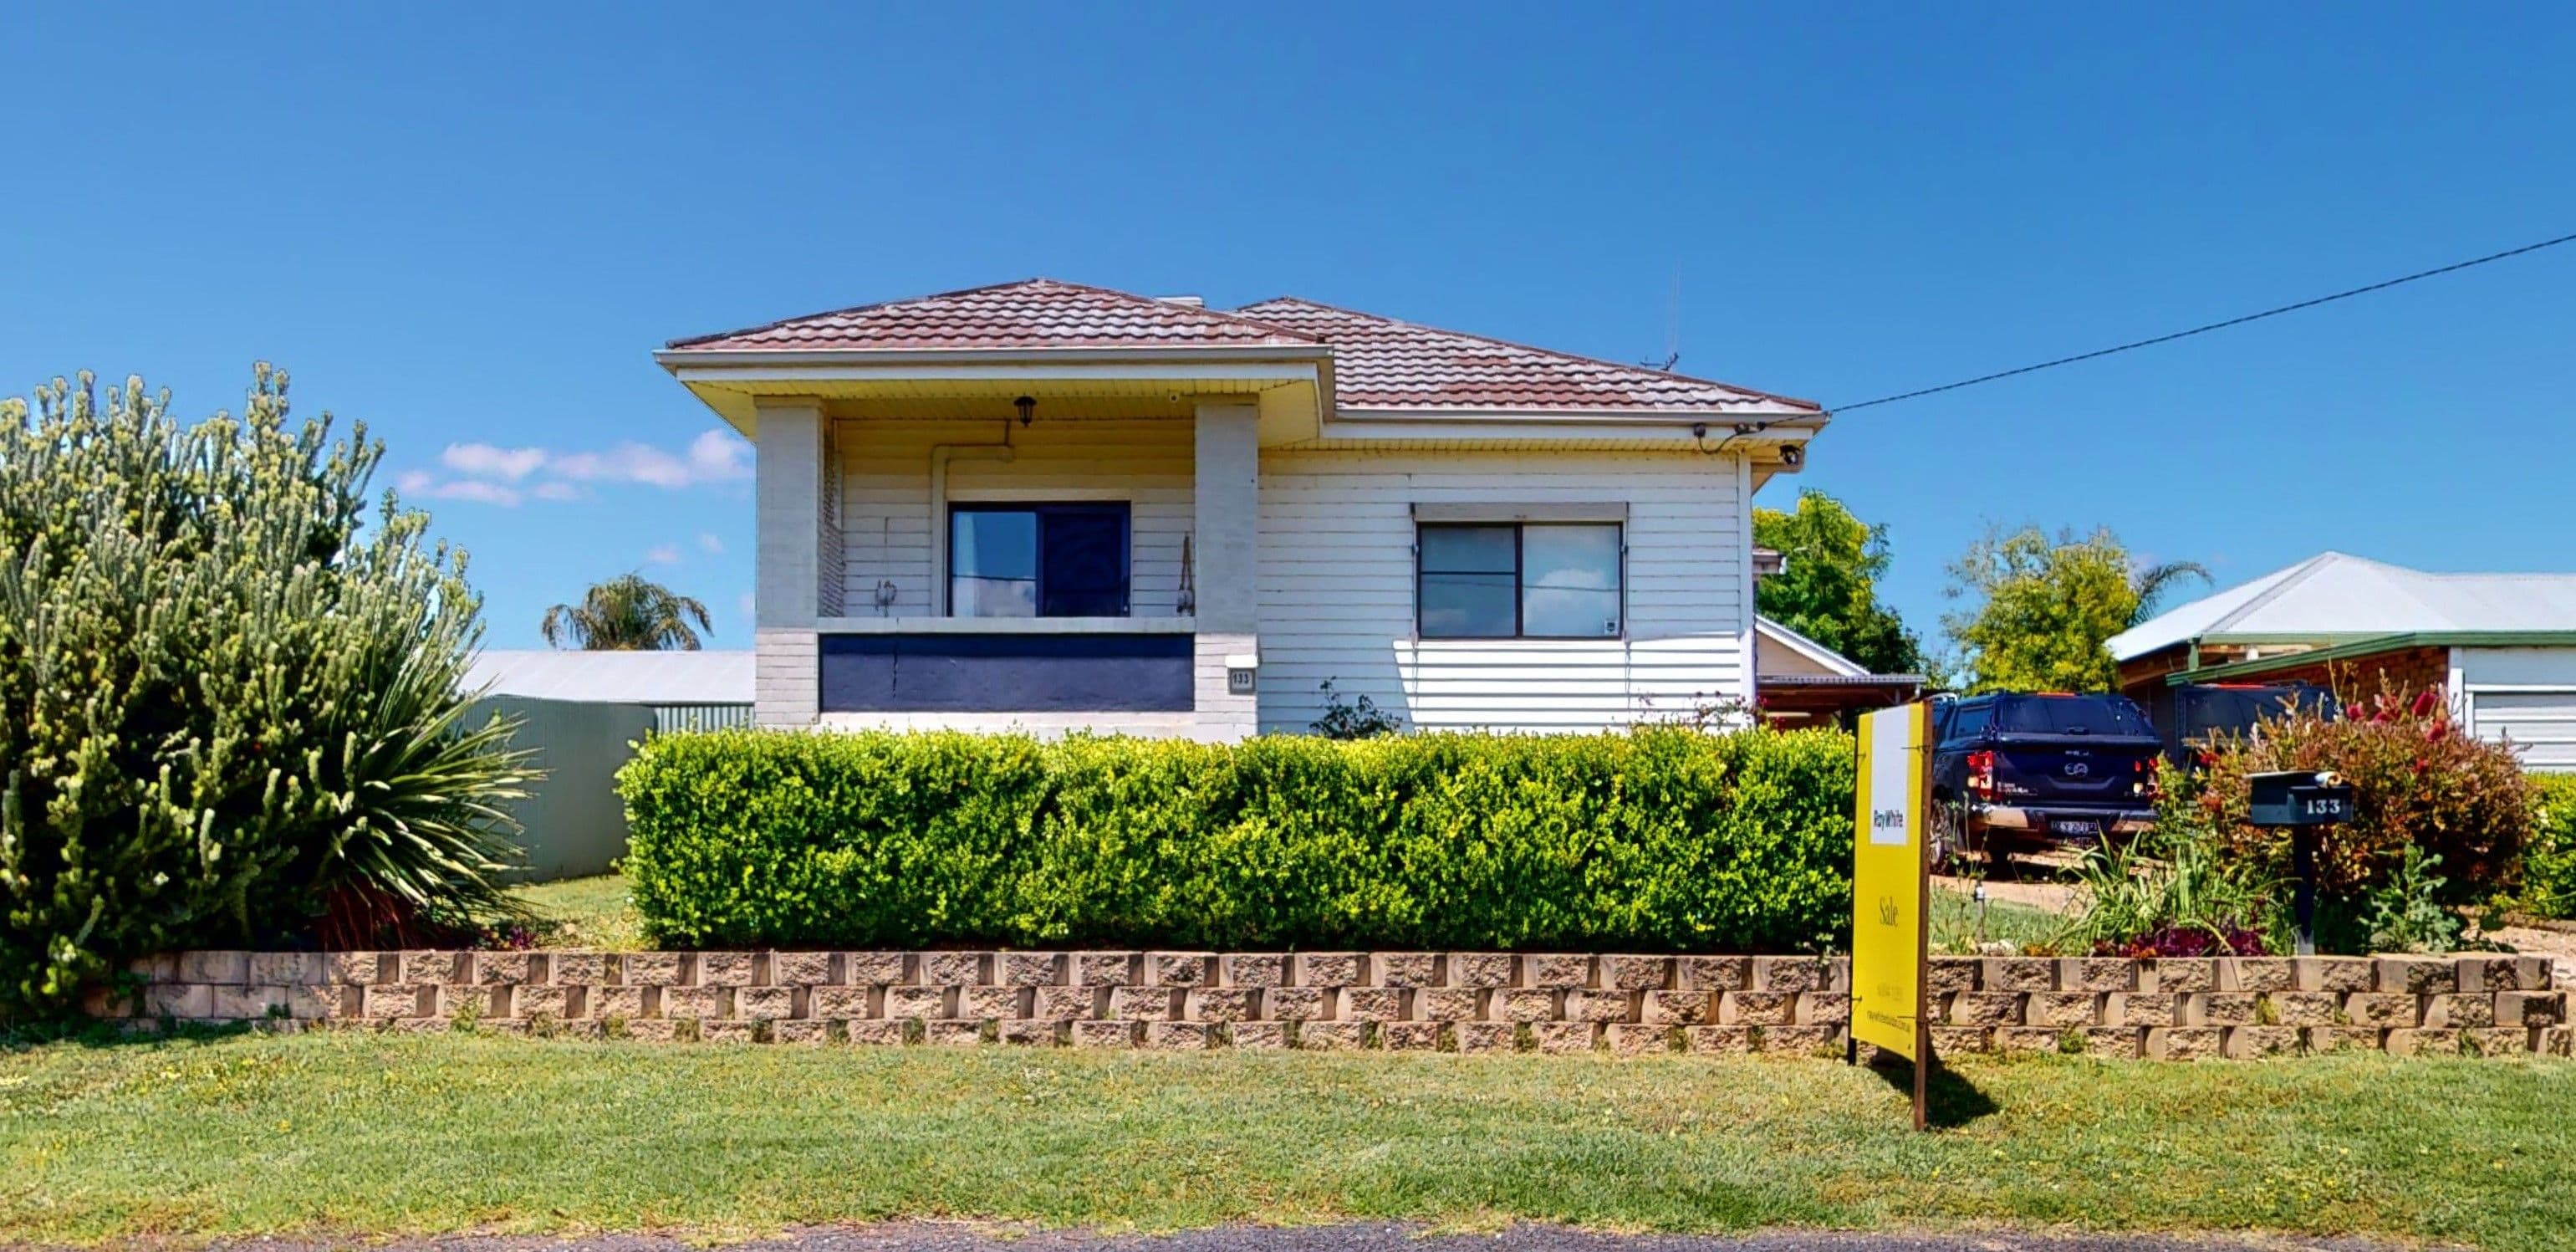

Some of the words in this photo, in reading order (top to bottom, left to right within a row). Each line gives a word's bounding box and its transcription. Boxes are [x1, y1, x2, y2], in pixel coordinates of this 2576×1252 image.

[1233, 673, 1249, 683] 133
[2307, 799, 2341, 815] 133
[1879, 896, 1899, 928] Sale
